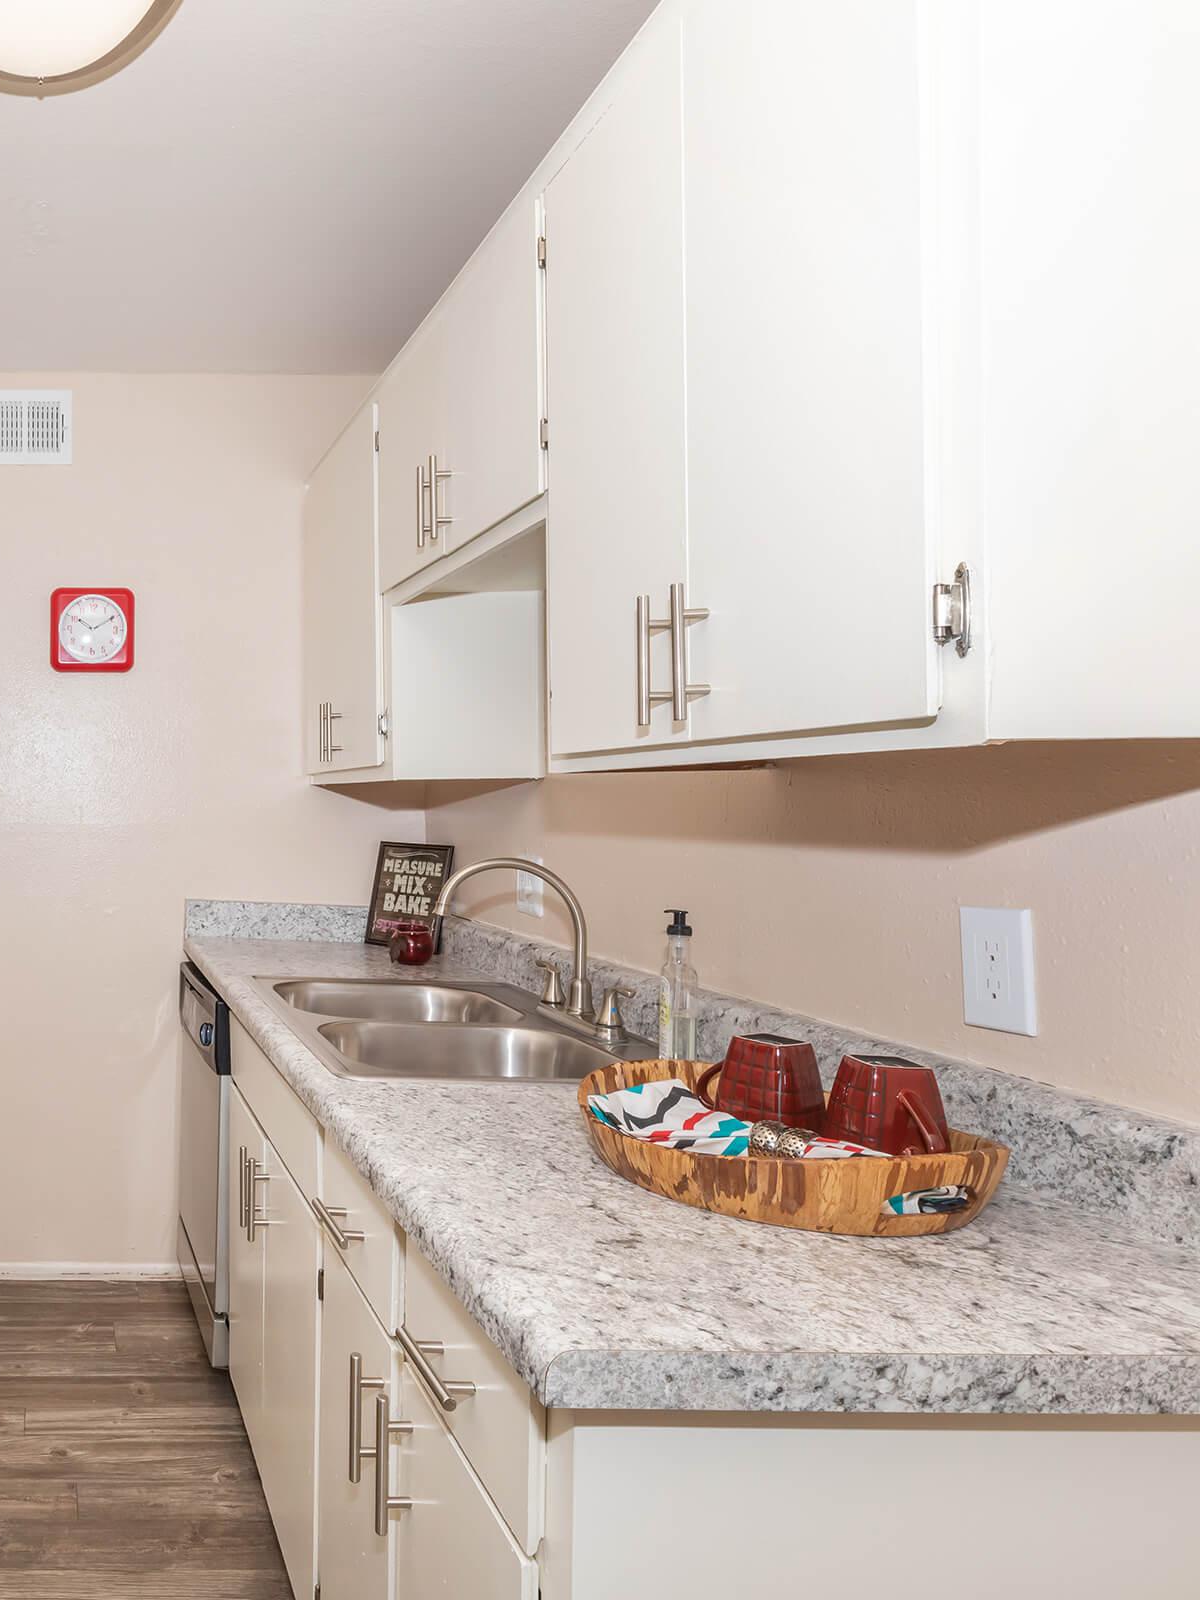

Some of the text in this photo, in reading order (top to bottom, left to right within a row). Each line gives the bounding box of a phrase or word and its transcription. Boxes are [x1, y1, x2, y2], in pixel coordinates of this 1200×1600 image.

[89, 603, 98, 613] 12
[71, 615, 79, 624] 10
[66, 624, 73, 634] 9
[112, 625, 119, 635] 3
[89, 647, 96, 656] 6
[383, 859, 443, 876] MEASURE
[392, 875, 427, 895] MIX
[383, 893, 431, 916] BAKE
